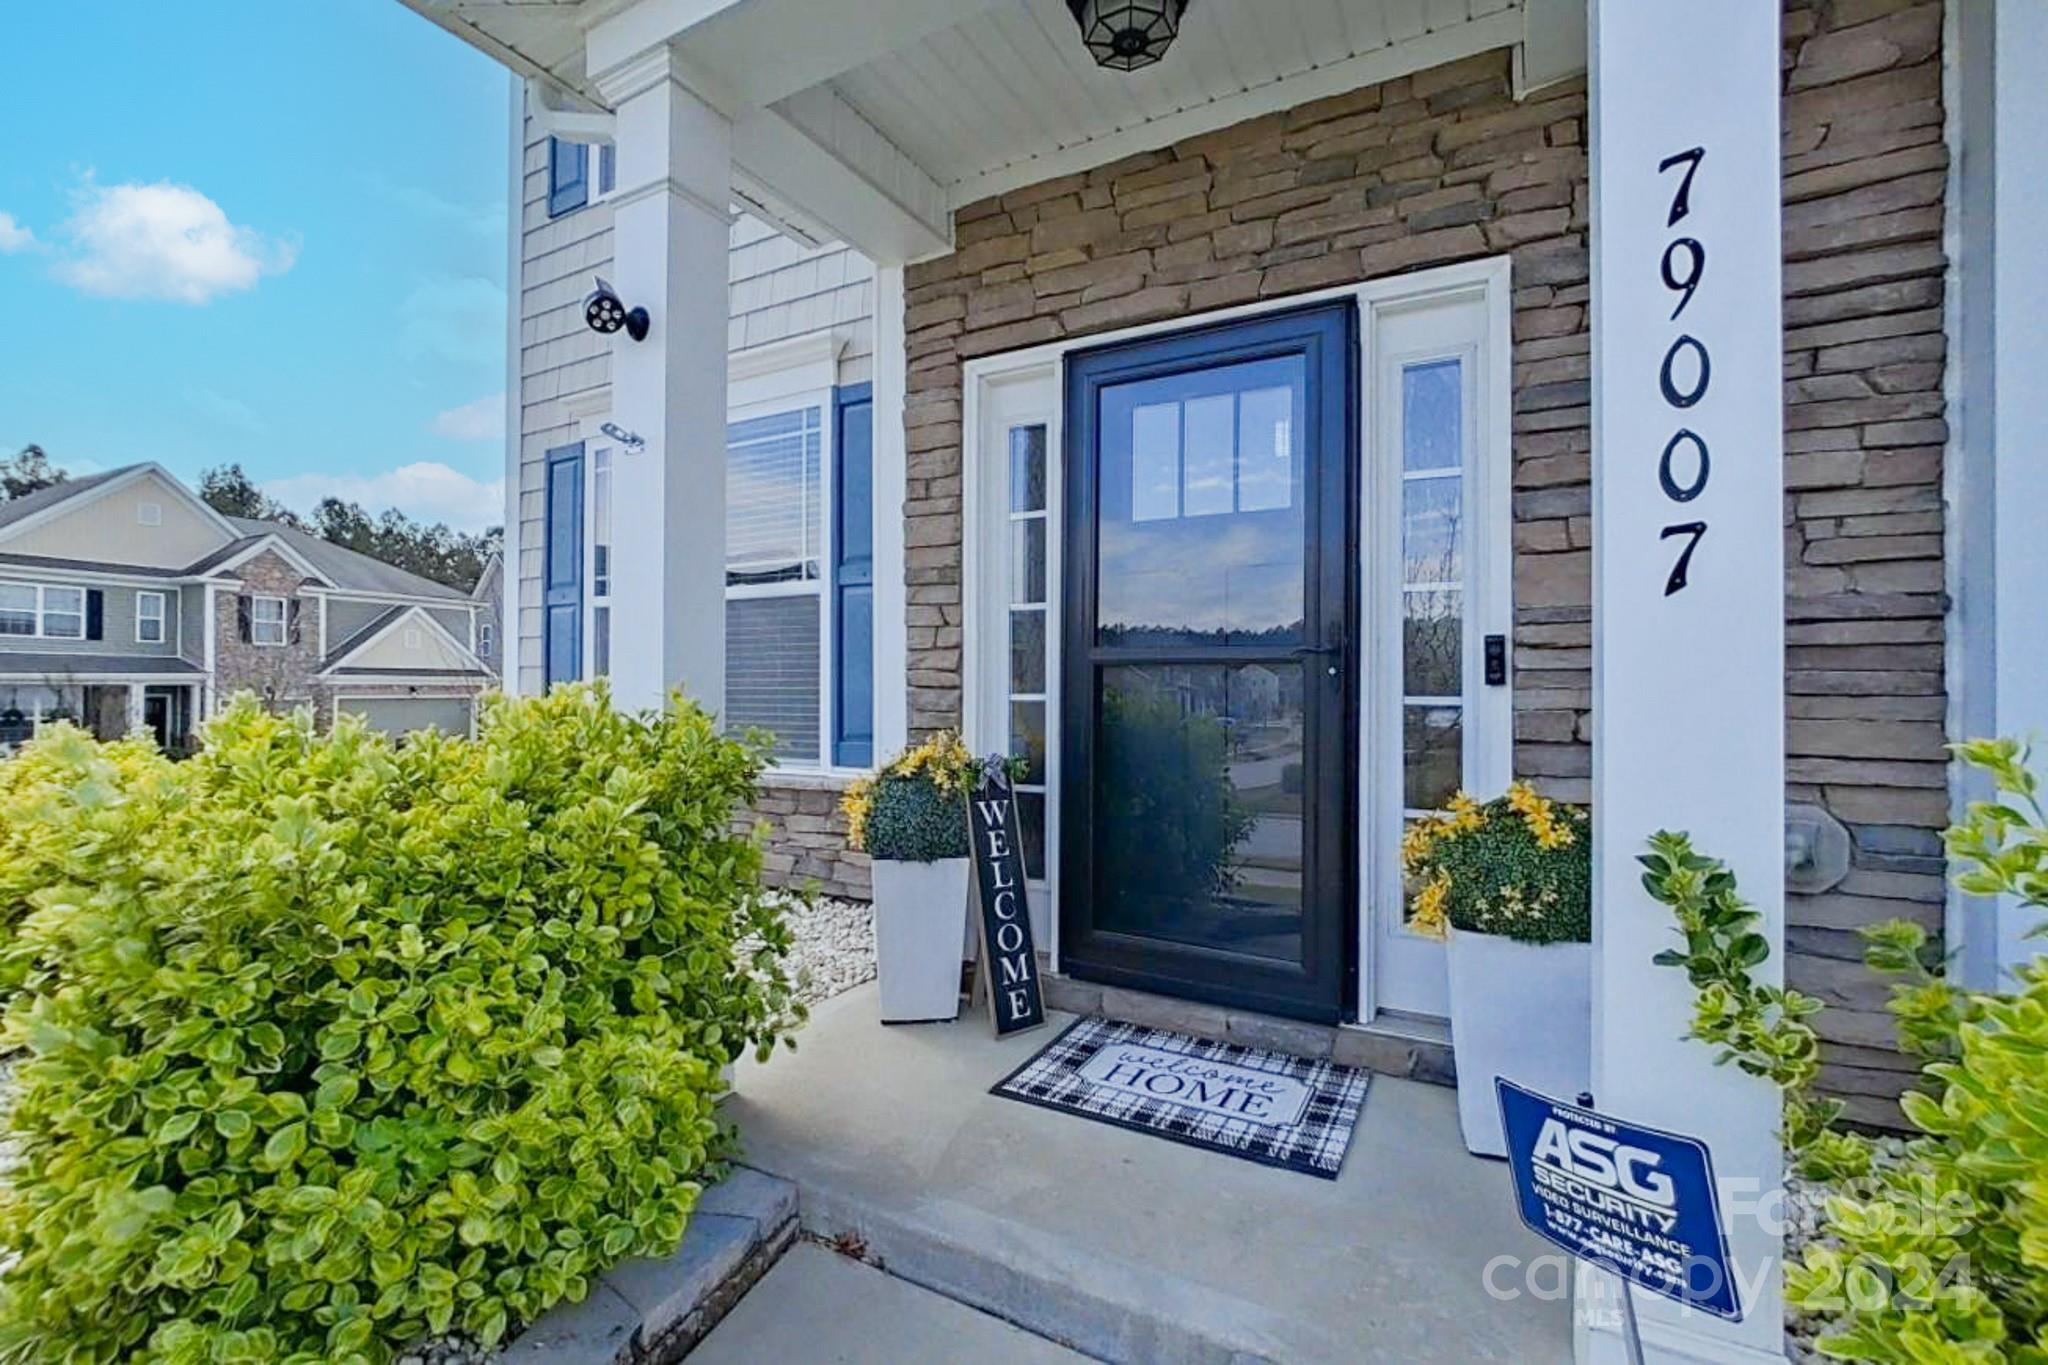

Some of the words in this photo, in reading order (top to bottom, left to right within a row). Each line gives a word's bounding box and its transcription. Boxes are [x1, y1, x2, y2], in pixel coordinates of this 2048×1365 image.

[1658, 145, 1711, 598] 79007
[976, 799, 1031, 1021] WELCOME
[1101, 1061, 1278, 1119] HOME
[1117, 1049, 1287, 1096] welcome
[1532, 1116, 1677, 1207] ASG
[1533, 1164, 1678, 1234] SECURITY
[1531, 1181, 1569, 1208] VIDEO
[1573, 1198, 1694, 1259] SURVEILLANCE
